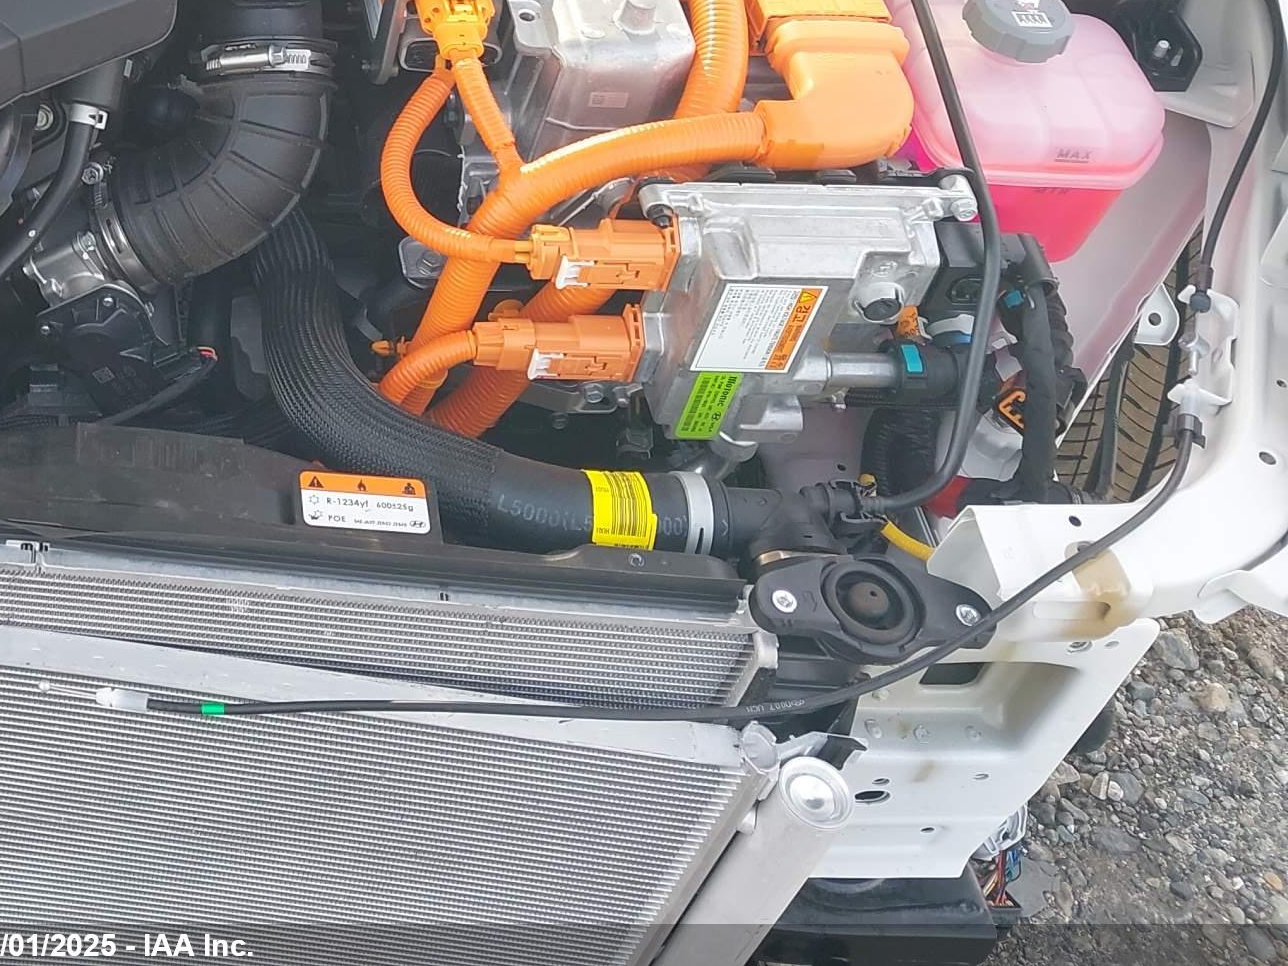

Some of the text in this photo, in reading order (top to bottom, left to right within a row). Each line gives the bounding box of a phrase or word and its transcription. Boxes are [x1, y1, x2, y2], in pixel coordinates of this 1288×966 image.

[792, 304, 812, 323] 경고
[326, 496, 414, 513] R-1234yf 600±25g
